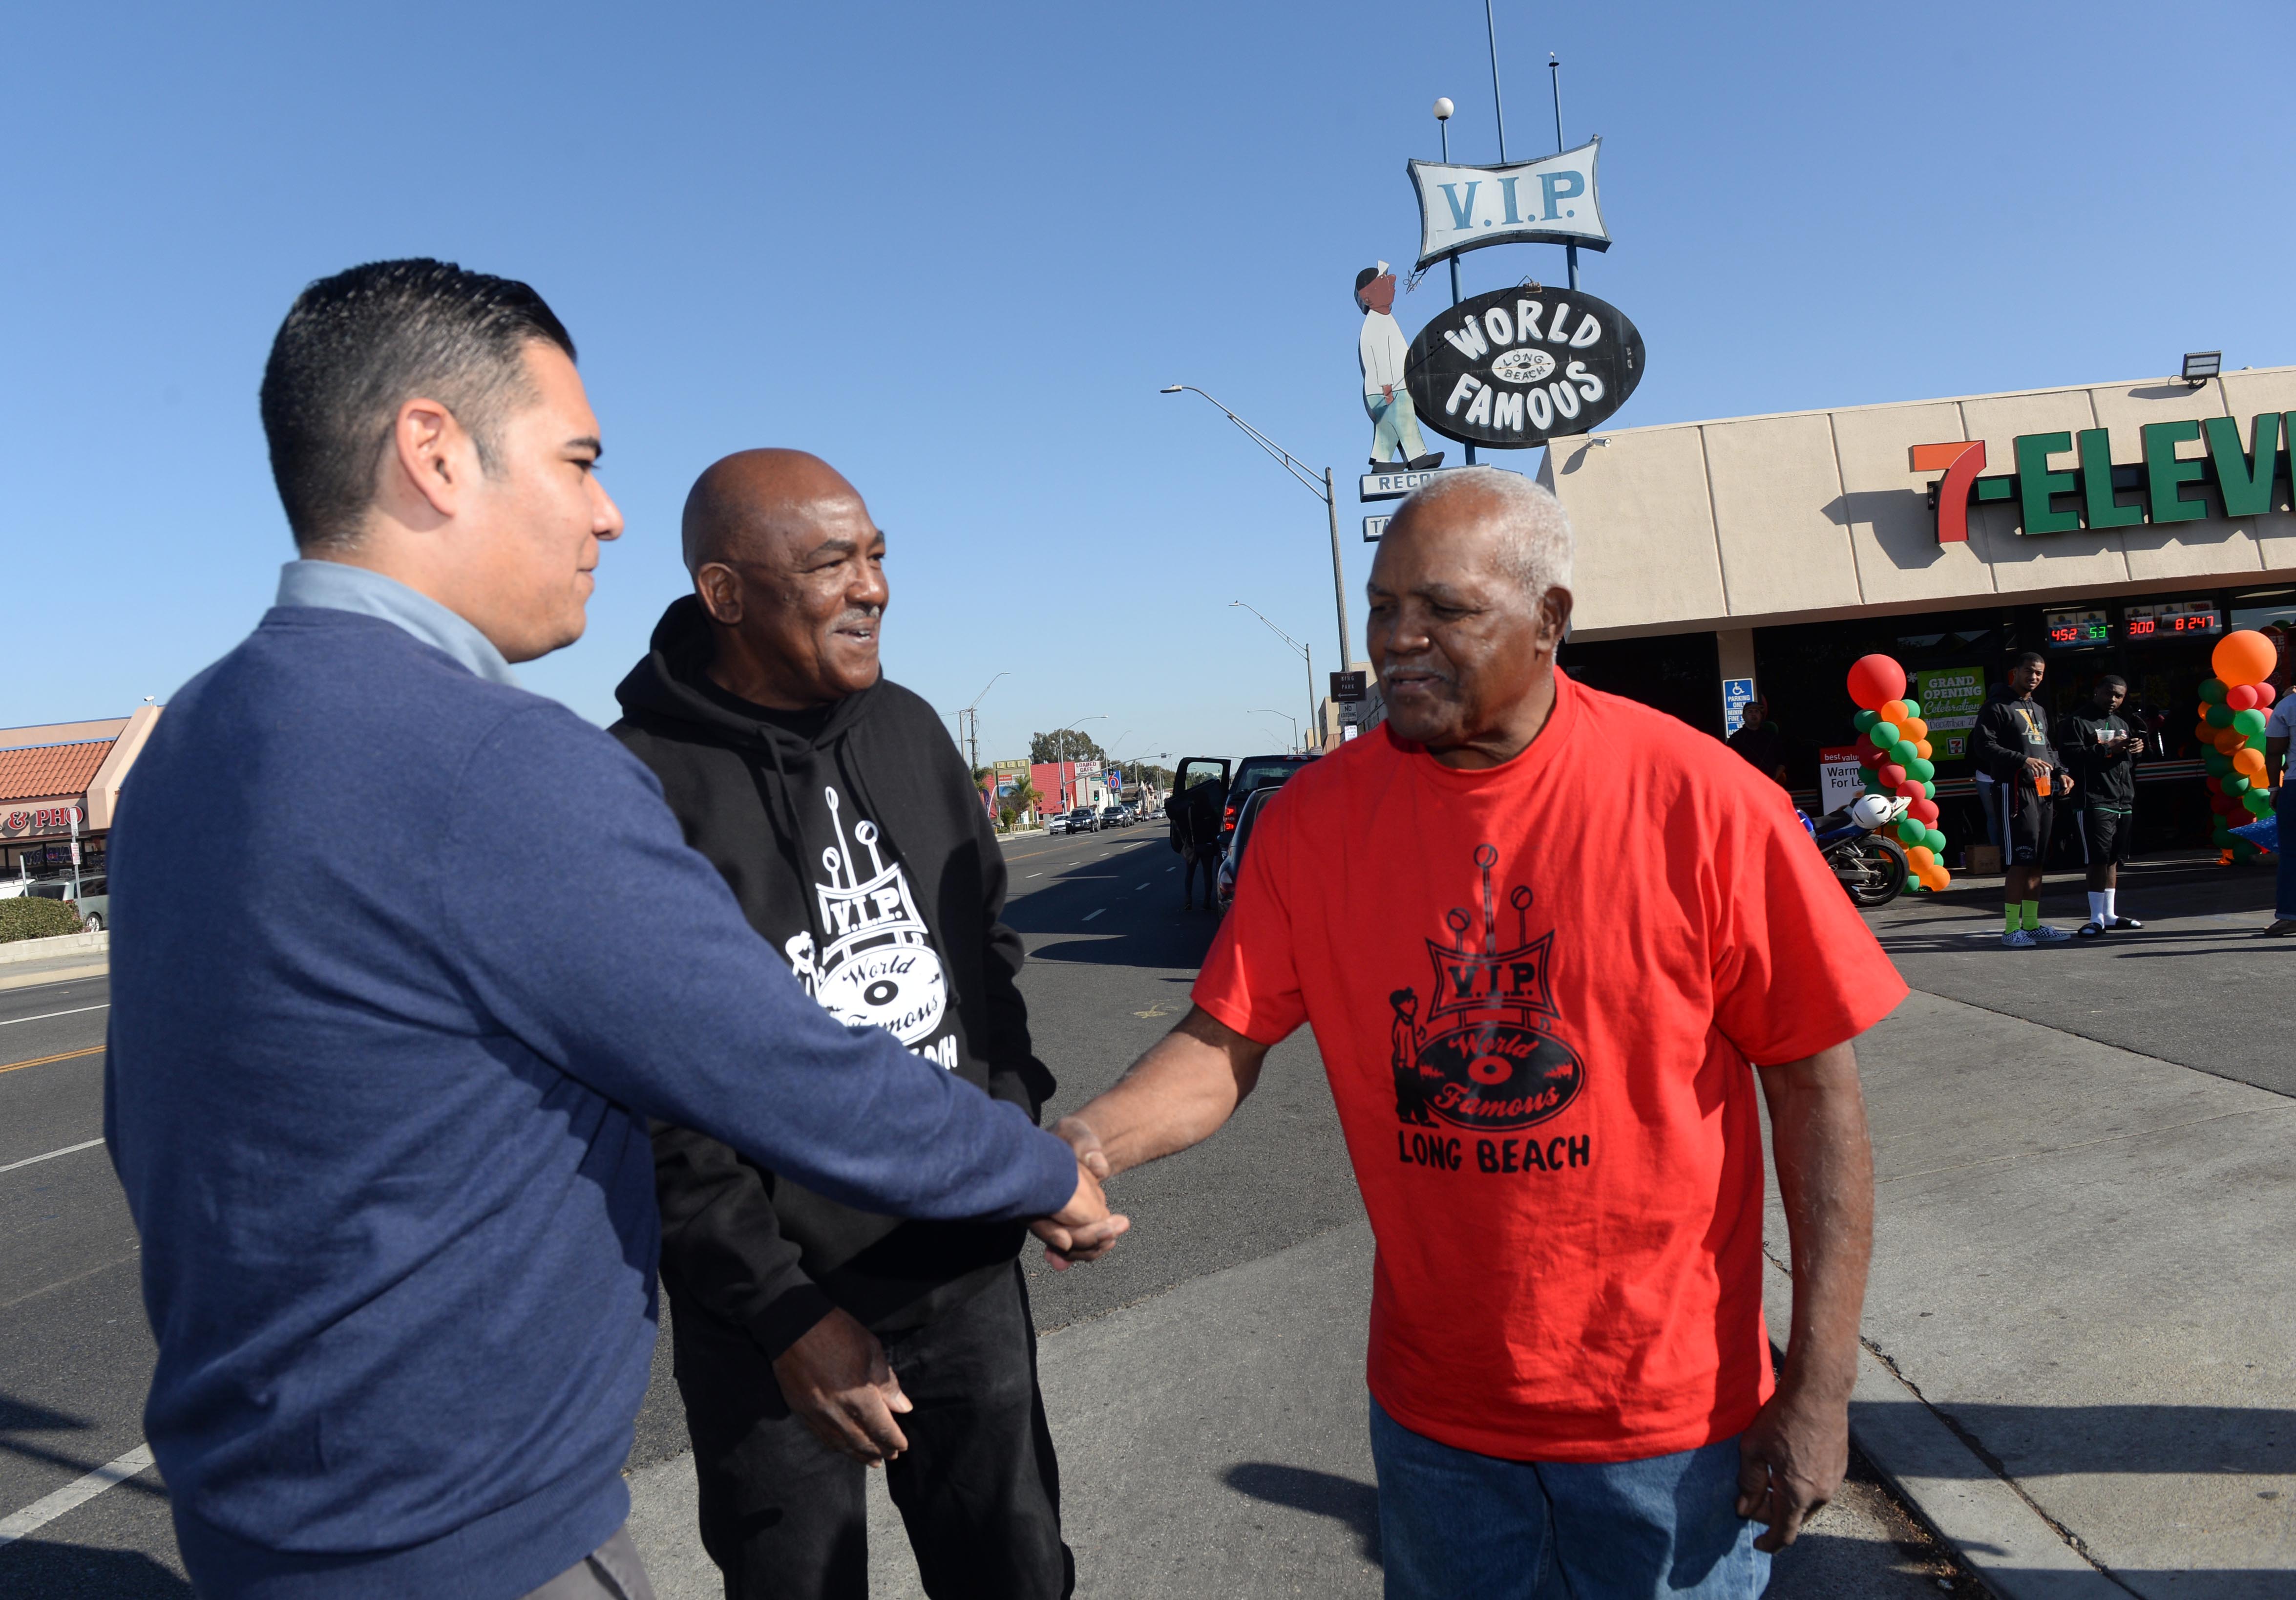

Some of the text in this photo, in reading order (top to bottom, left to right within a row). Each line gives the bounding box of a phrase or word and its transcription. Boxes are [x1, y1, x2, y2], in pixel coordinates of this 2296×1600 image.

[1437, 170, 1585, 231] V.I.P.
[1444, 299, 1601, 361] WORLD
[1503, 353, 1544, 365] LONG
[1503, 366, 1546, 381] BEACH
[1446, 361, 1605, 432] FAMOUS
[1379, 472, 1439, 491] RECO
[1909, 411, 2296, 543] 7-ELEV
[2051, 626, 2106, 641] 452 53
[2129, 615, 2214, 635] 300 8 247
[1923, 686, 1982, 700] OPENING
[1928, 676, 1975, 688] GRAND
[1923, 698, 1981, 715] Celebration
[1930, 719, 1965, 729] December
[1108, 771, 1119, 788] 6
[1832, 778, 1848, 788] For
[8, 811, 28, 830] &
[35, 806, 83, 828] PHO
[830, 886, 903, 936] V.I.P.
[842, 955, 916, 988] World
[1448, 962, 1535, 998] V.I.P.
[847, 995, 938, 1033] Fmous
[1448, 1029, 1539, 1059] World
[1433, 1082, 1560, 1117] Famous
[1398, 1130, 1590, 1173] LONG BEACH
